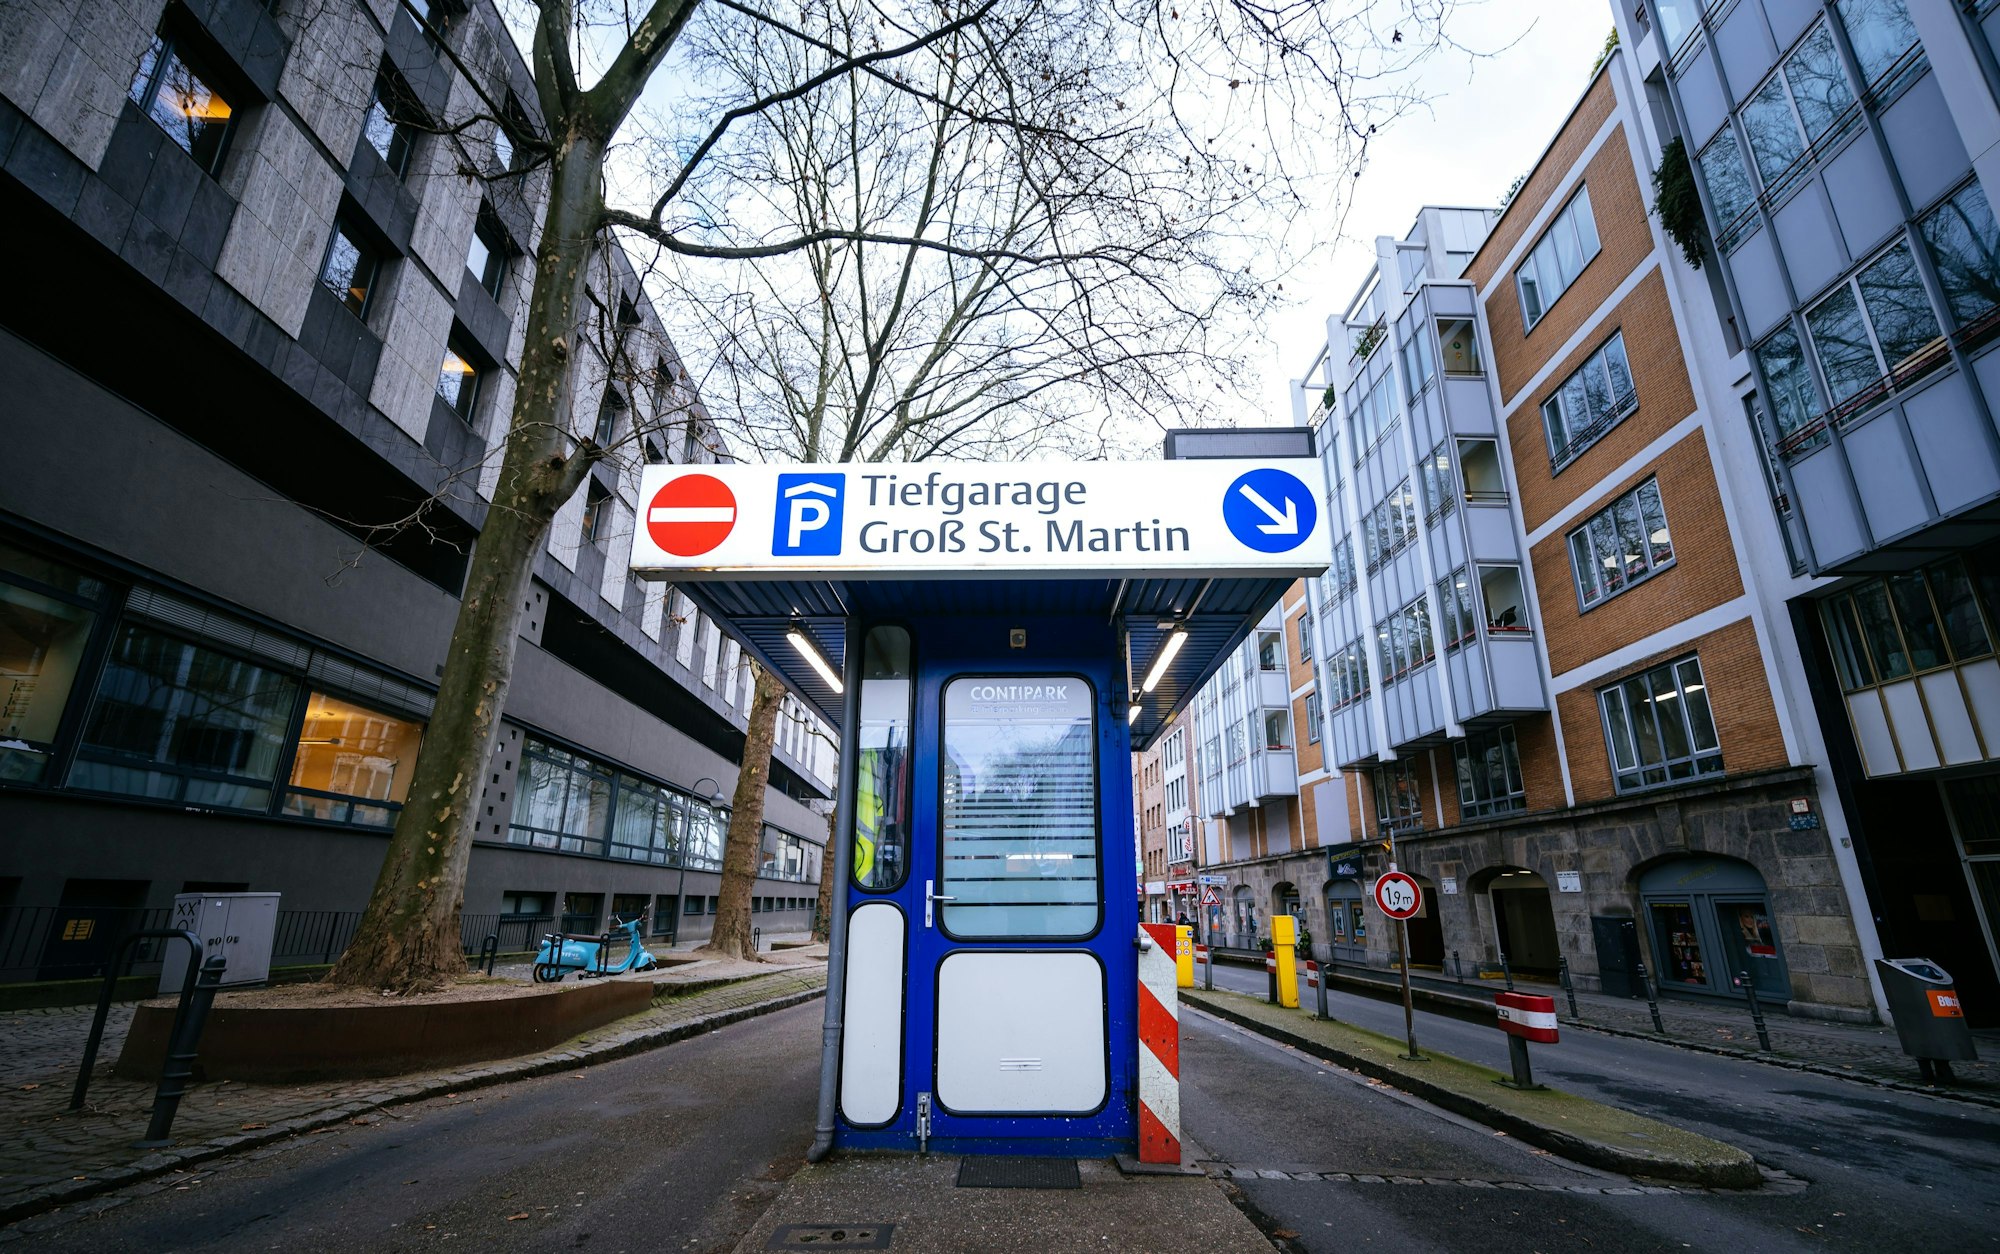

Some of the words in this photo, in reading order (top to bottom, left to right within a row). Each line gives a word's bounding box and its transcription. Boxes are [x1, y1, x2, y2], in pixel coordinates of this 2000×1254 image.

[861, 472, 1087, 515] Tiefgarage
[860, 520, 965, 553] Groß
[979, 520, 1031, 553] St.
[1046, 518, 1190, 553] Martin
[970, 685, 1067, 701] CONTIPARK
[1385, 886, 1401, 906] 1,9
[1402, 896, 1413, 905] m
